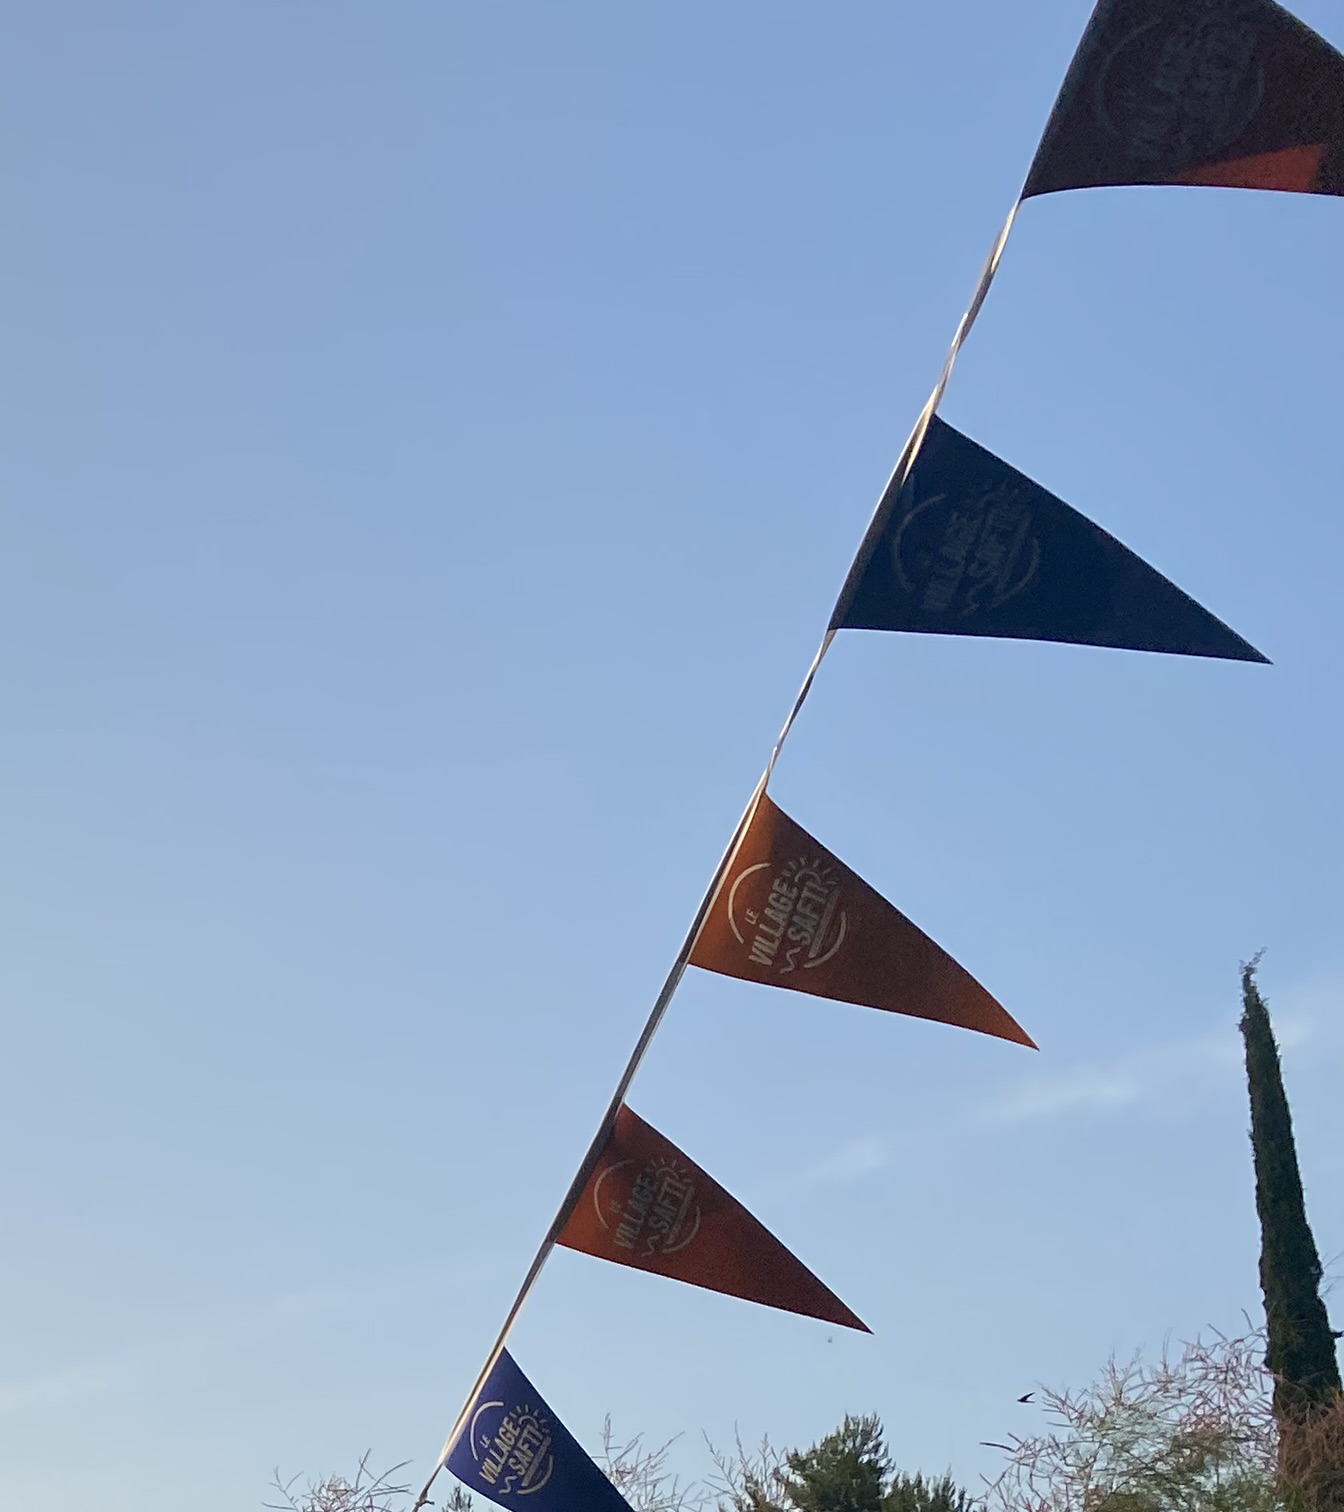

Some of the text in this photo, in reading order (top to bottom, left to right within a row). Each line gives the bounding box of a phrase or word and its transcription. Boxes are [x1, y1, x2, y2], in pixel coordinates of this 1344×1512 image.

[745, 908, 759, 925] LE
[748, 879, 798, 966] VILLAGE
[787, 881, 829, 945] SAFTI
[479, 1416, 520, 1484] VILLAGE
[508, 1424, 544, 1475] SAFTI
